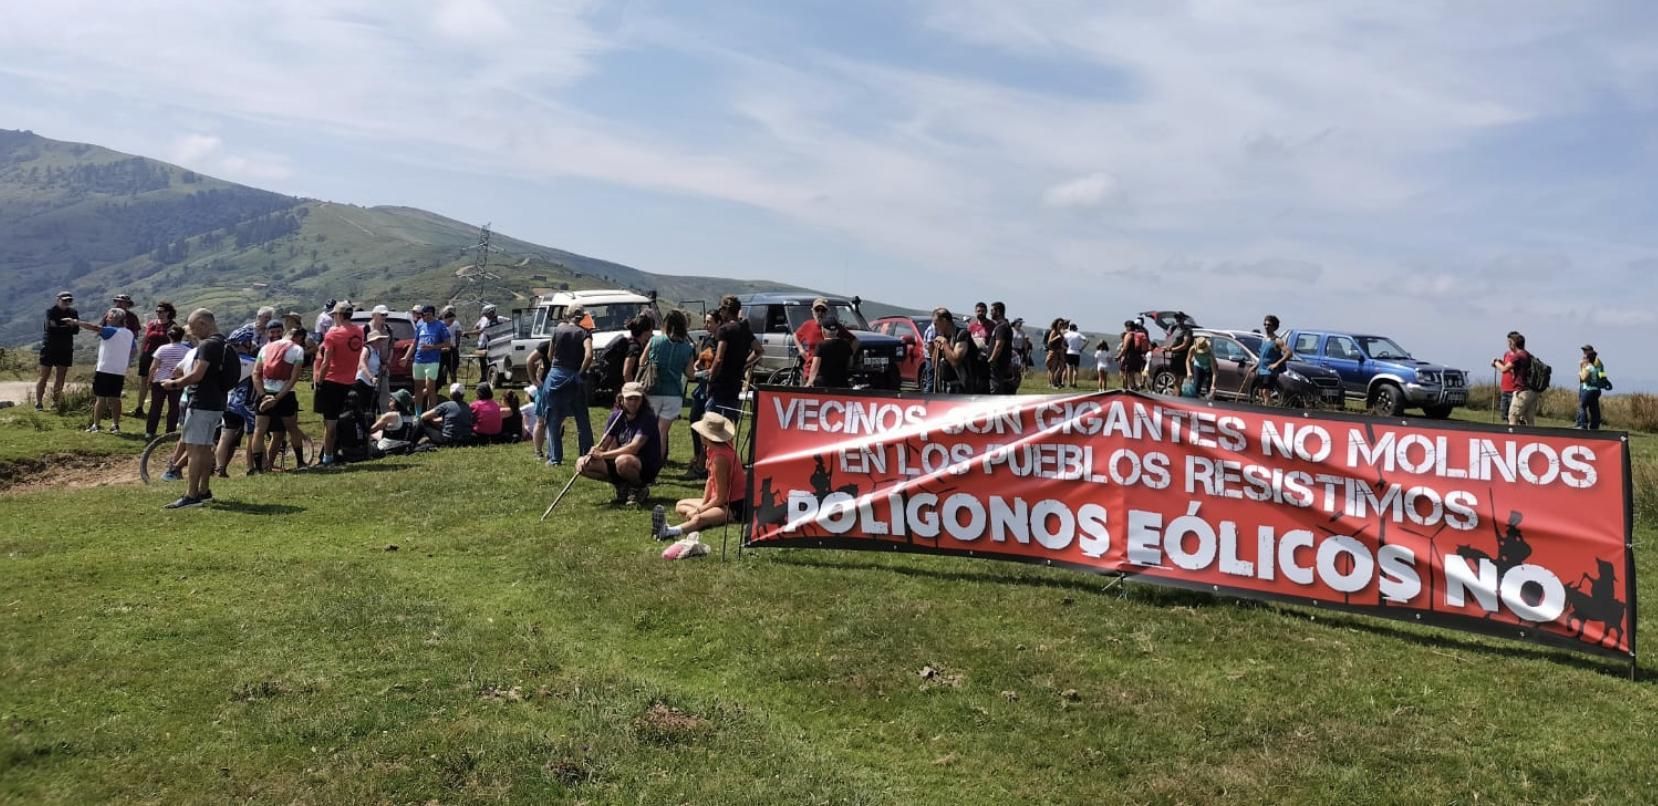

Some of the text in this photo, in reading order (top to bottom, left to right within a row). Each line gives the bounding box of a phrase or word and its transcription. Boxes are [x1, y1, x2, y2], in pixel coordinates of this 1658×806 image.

[773, 397, 1598, 489] VECINOS SON GIGANTES NO MOLINOS
[839, 442, 1479, 531] EN LOS PUEBLOS RESISTIMOS
[1127, 501, 1421, 604] EÓLICOS
[1444, 554, 1566, 623] NO
